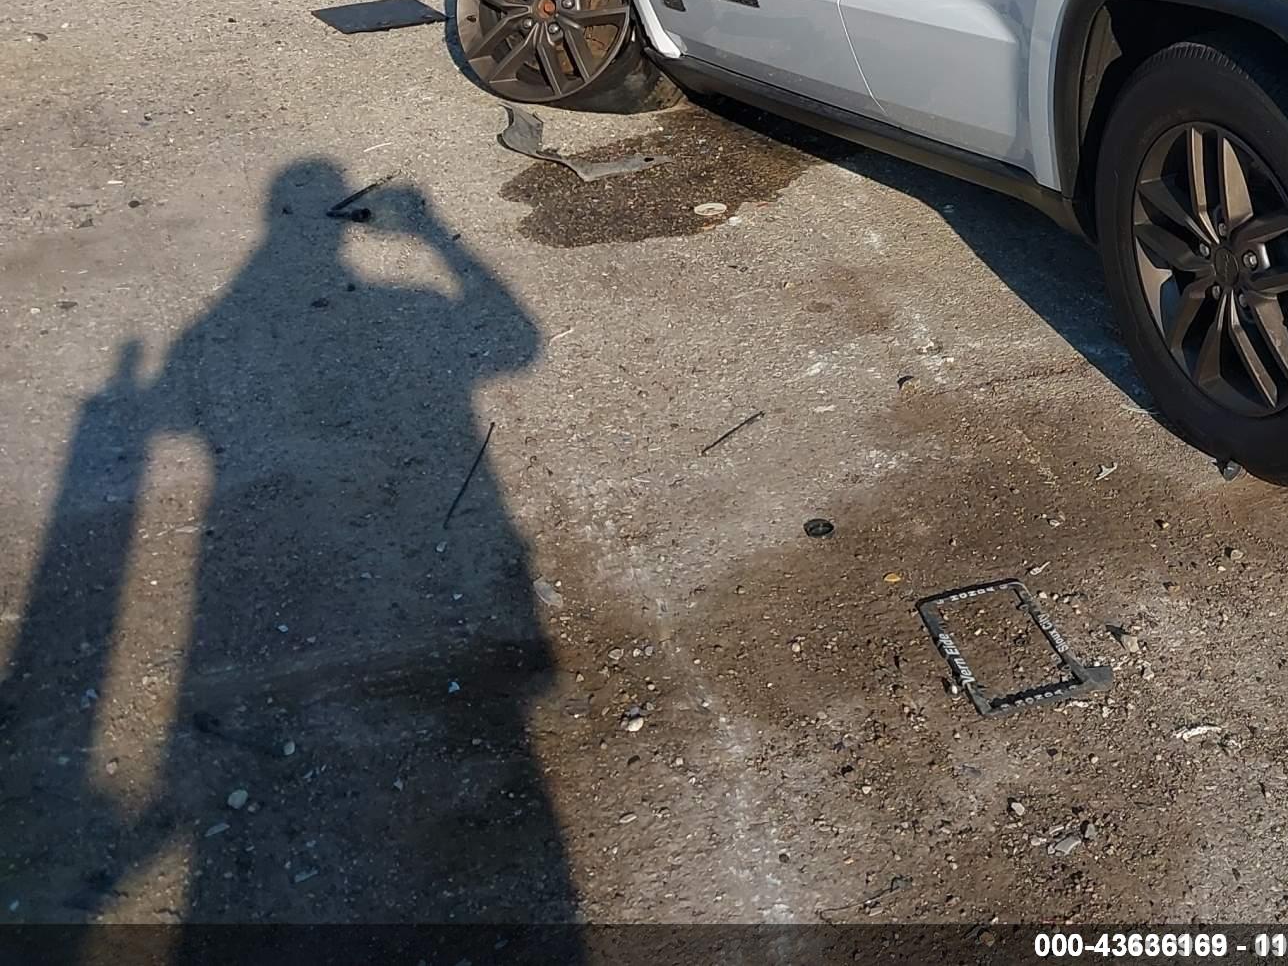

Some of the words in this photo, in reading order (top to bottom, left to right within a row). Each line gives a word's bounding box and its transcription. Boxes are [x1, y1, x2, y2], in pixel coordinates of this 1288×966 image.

[1037, 613, 1053, 631] City
[938, 633, 961, 655] Eide
[1048, 628, 1070, 653] Sioux
[953, 658, 976, 687] Vern
